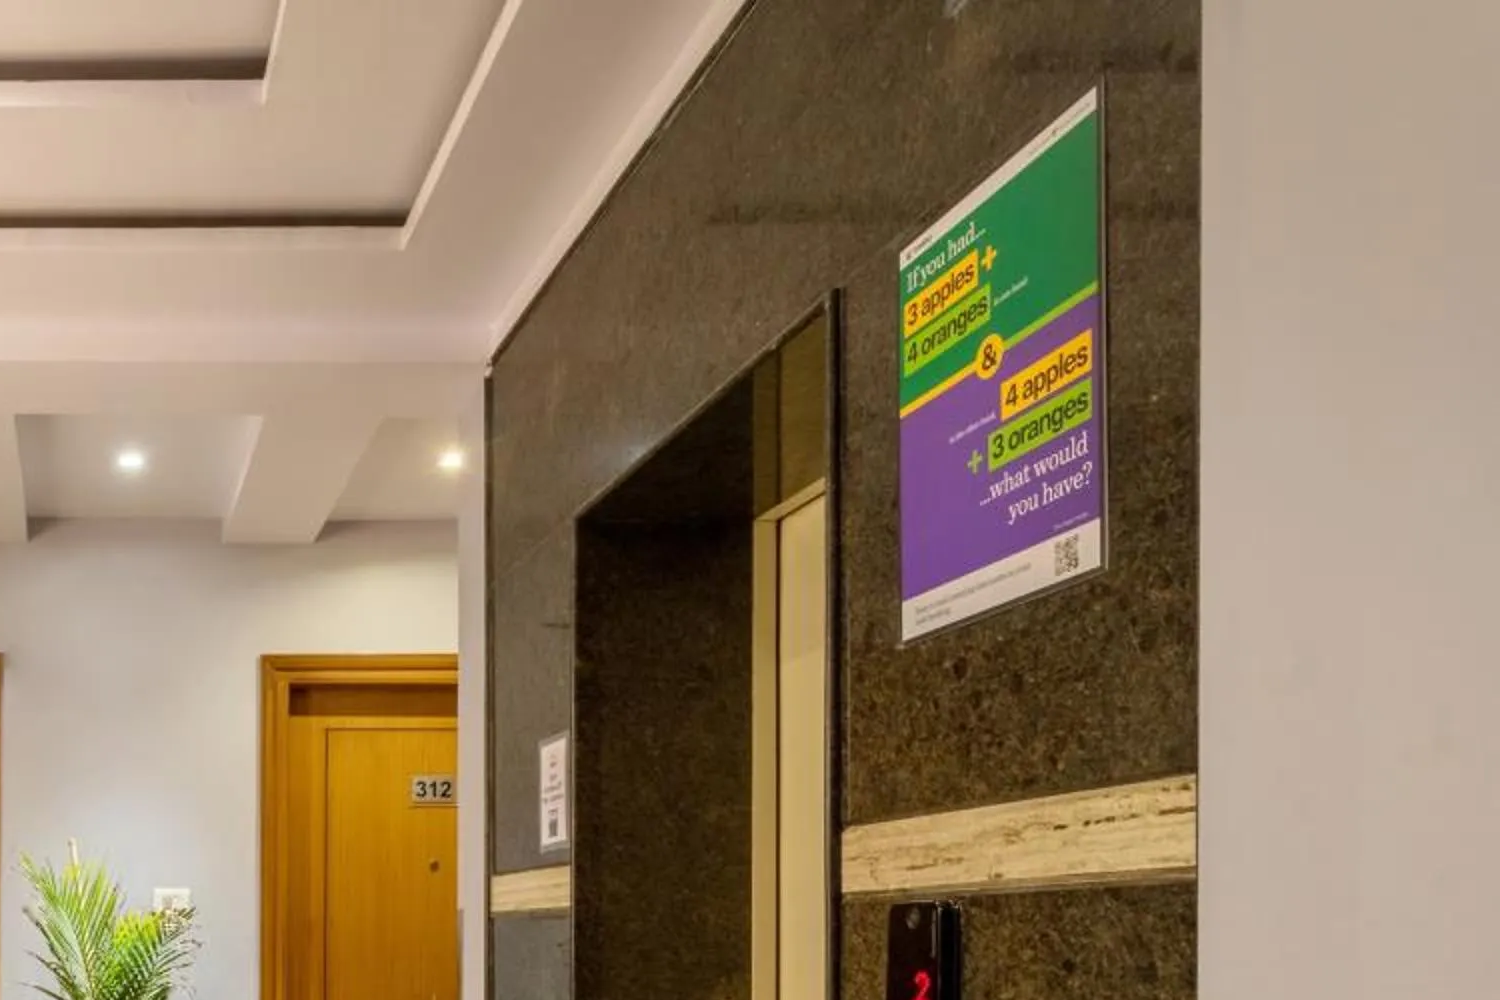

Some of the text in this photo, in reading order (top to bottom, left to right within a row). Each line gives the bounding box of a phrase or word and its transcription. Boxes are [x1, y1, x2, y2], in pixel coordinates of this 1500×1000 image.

[907, 264, 921, 293] If
[916, 251, 946, 286] you
[907, 302, 918, 327] 3
[921, 263, 975, 317] apples
[907, 295, 989, 362] 4 oranges
[981, 342, 998, 371] &
[1005, 345, 1089, 407] 4 apples
[991, 432, 1005, 460] 3
[1008, 391, 1089, 451] oranges
[1032, 431, 1089, 478] would
[1007, 493, 1040, 526] you
[1041, 461, 1093, 506] have?
[415, 781, 452, 798] 312
